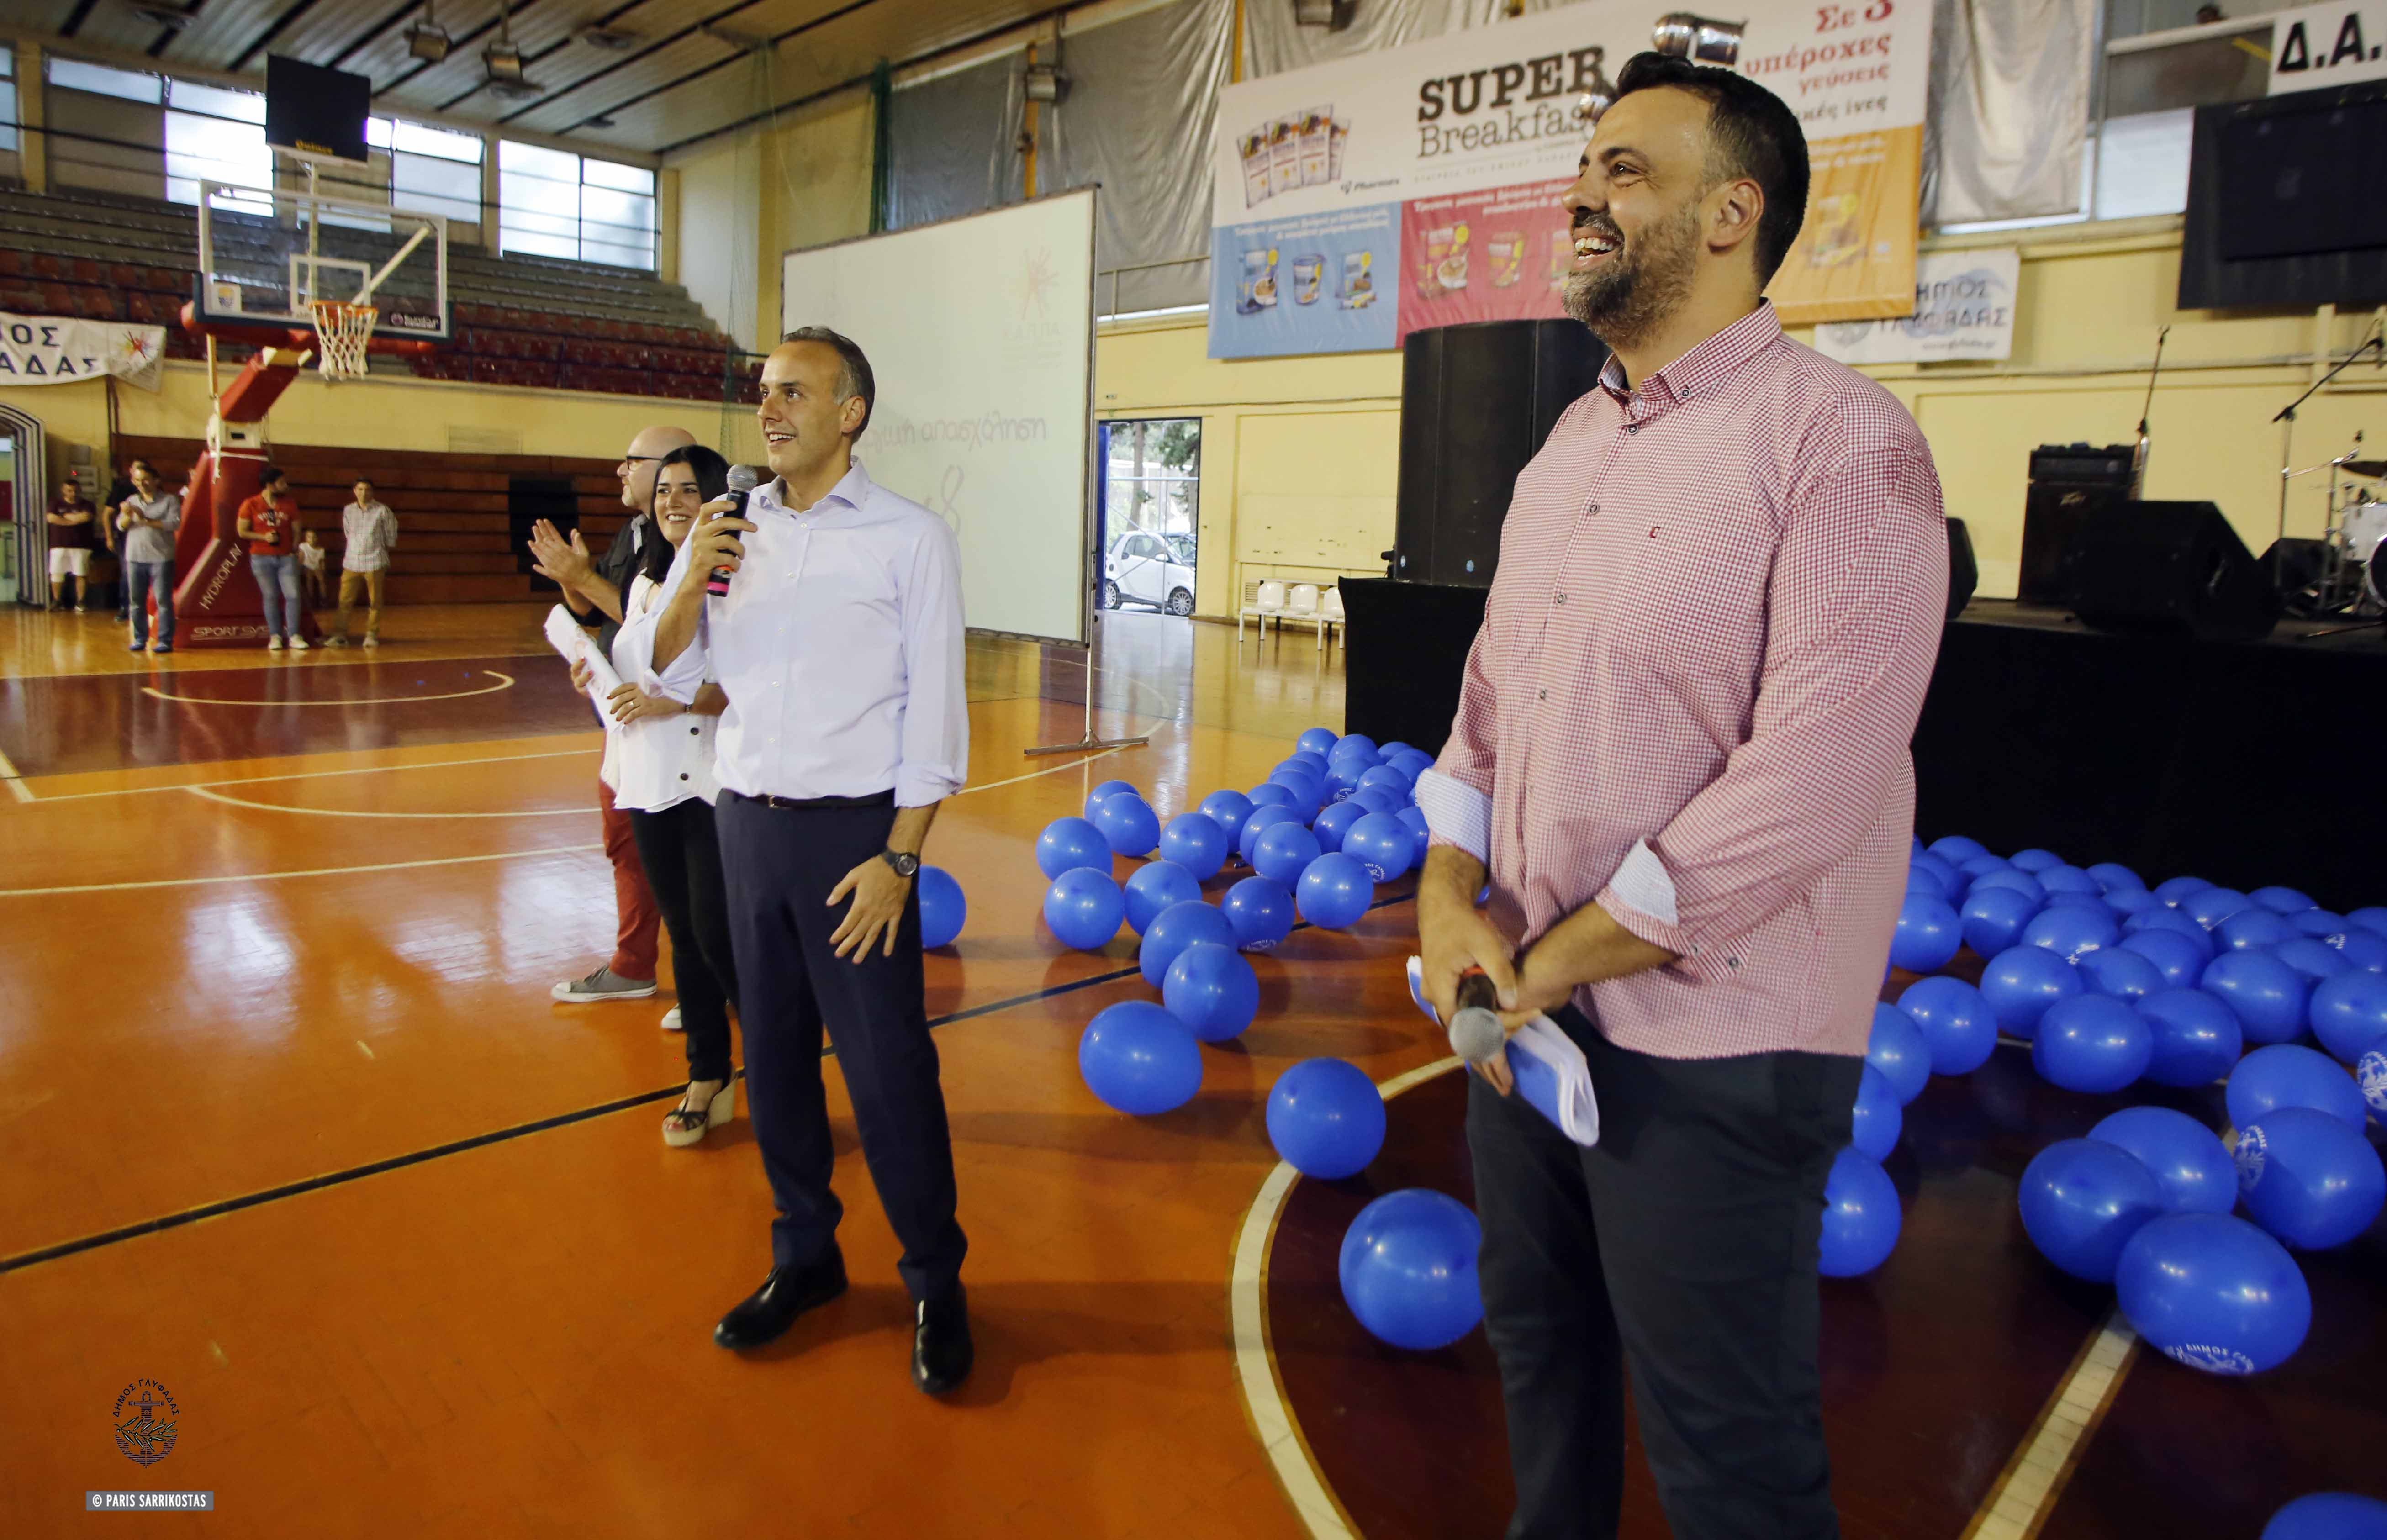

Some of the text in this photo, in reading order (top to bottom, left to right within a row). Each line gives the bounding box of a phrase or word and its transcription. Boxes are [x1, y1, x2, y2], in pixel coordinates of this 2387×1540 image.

[1816, 5, 1856, 32] Σε
[1744, 34, 1892, 76] υπέροχες
[2277, 11, 2387, 72] Δ.Α.
[1418, 45, 1605, 122] SUPER
[1799, 64, 1891, 95] γεύσεις
[1846, 95, 1887, 116] ίνες
[1916, 279, 1991, 302] ΗΜΟΣ
[0, 322, 60, 347] ΟΣ
[199, 543, 243, 610] HYDROPLAY
[193, 626, 238, 637] SPORT
